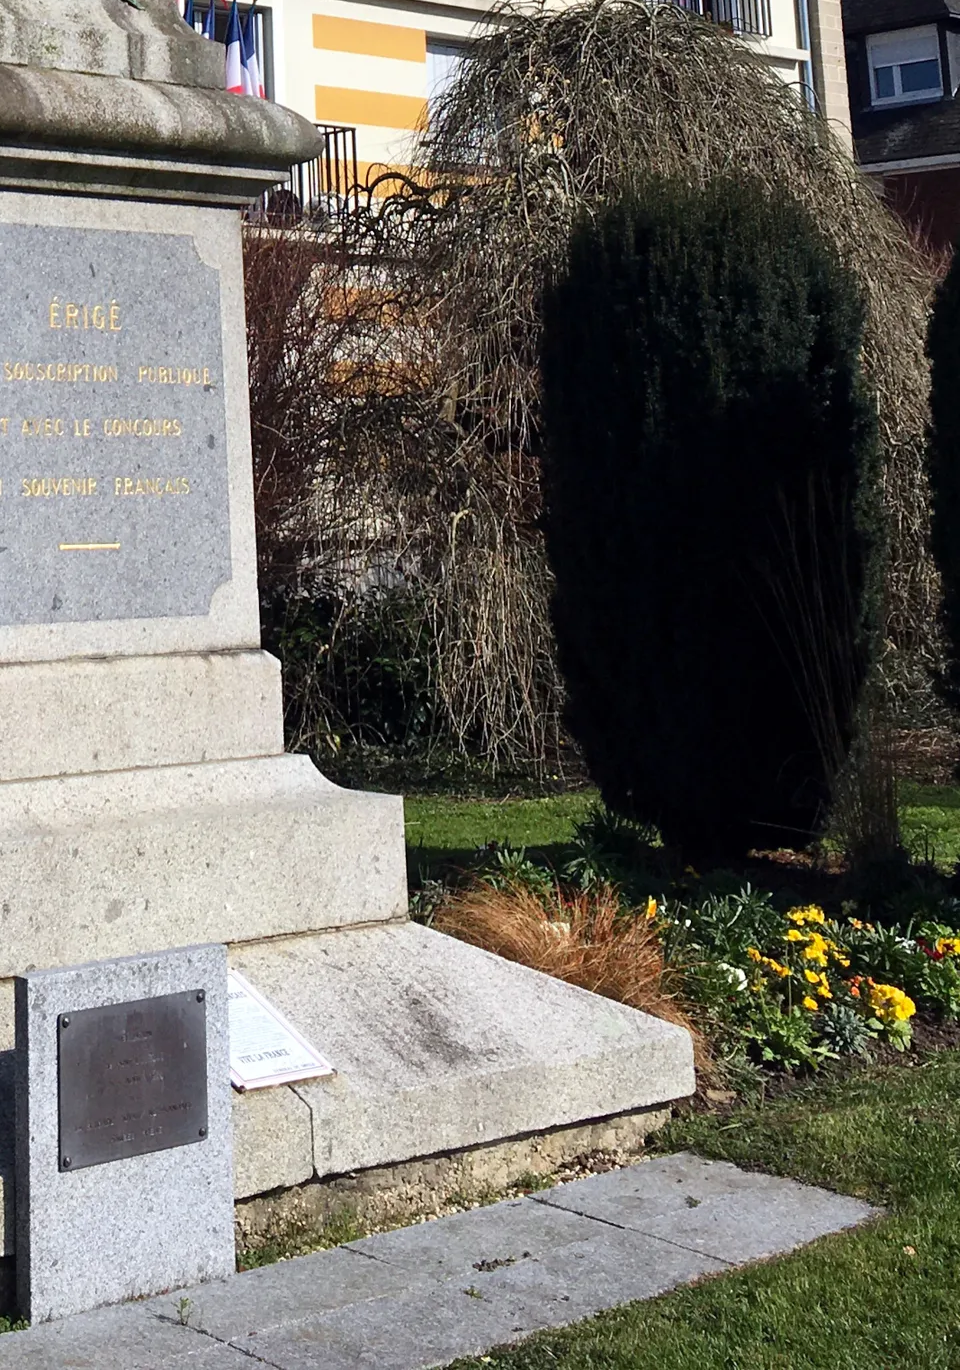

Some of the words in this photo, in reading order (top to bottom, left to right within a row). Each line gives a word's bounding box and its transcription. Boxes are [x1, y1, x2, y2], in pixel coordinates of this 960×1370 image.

[49, 295, 122, 331] ÉRIGÉ
[3, 362, 118, 383] SOUSCRIPTION
[138, 365, 212, 387] PUBLIQUE
[21, 417, 65, 436] AVEC
[74, 418, 92, 437] LE
[104, 418, 182, 437] CONCOURS
[21, 477, 97, 497] SOUVENIR
